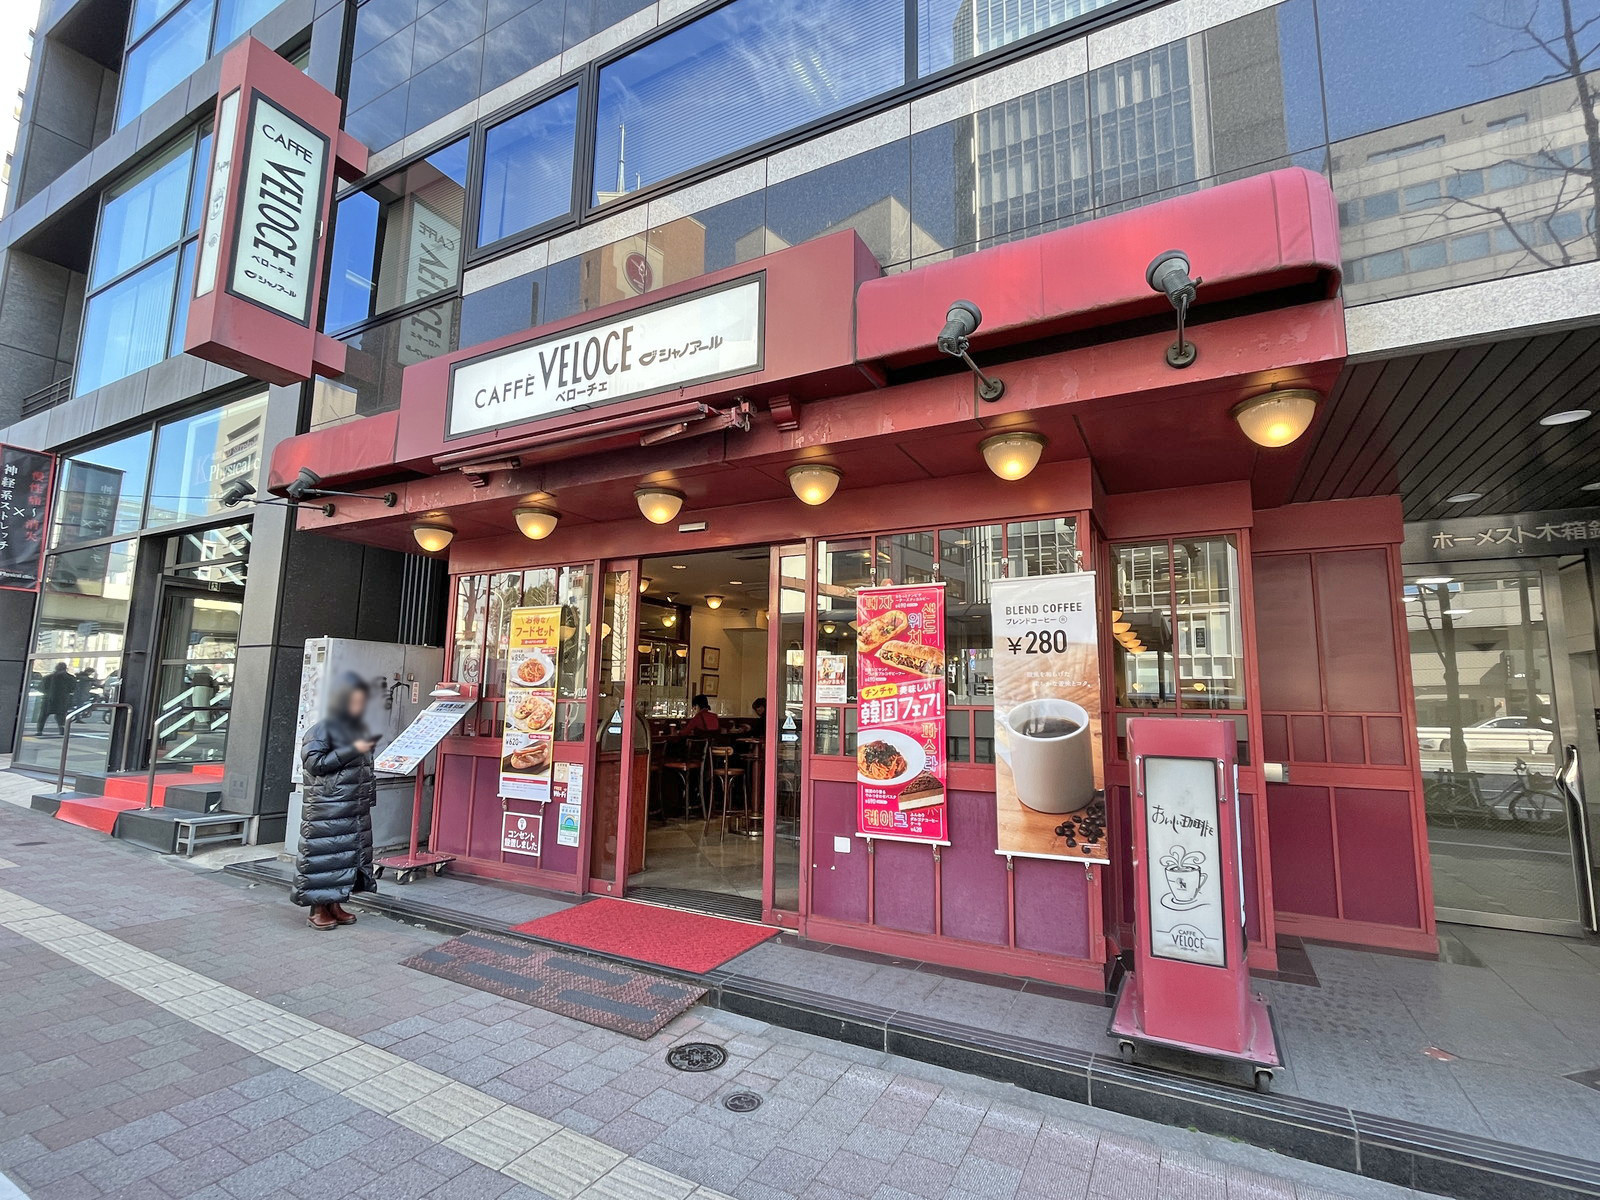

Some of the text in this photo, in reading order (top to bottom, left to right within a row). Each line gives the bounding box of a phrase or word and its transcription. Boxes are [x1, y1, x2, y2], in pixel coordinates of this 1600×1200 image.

[262, 124, 313, 164] CAFFE
[253, 159, 306, 267] VELOCE
[252, 255, 294, 278] ベローチェ
[258, 276, 297, 298] シャノアール
[659, 335, 723, 363] シャノアール
[475, 325, 634, 409] CAFFÈ VELOCE
[555, 381, 608, 402] ベローチェ
[209, 455, 252, 481] Physical
[0, 464, 18, 550] 神経系ストレッチ
[1006, 602, 1082, 615] BLEND COFFEE
[515, 626, 555, 637] フードセット
[525, 616, 546, 625] お得な
[1007, 629, 1067, 655] ¥280
[865, 686, 894, 697] チンチャ
[861, 693, 941, 725] 韓国フェア!
[504, 838, 537, 850] 設置しました
[508, 830, 535, 841] コンセント
[1172, 934, 1205, 950] VELOCE
